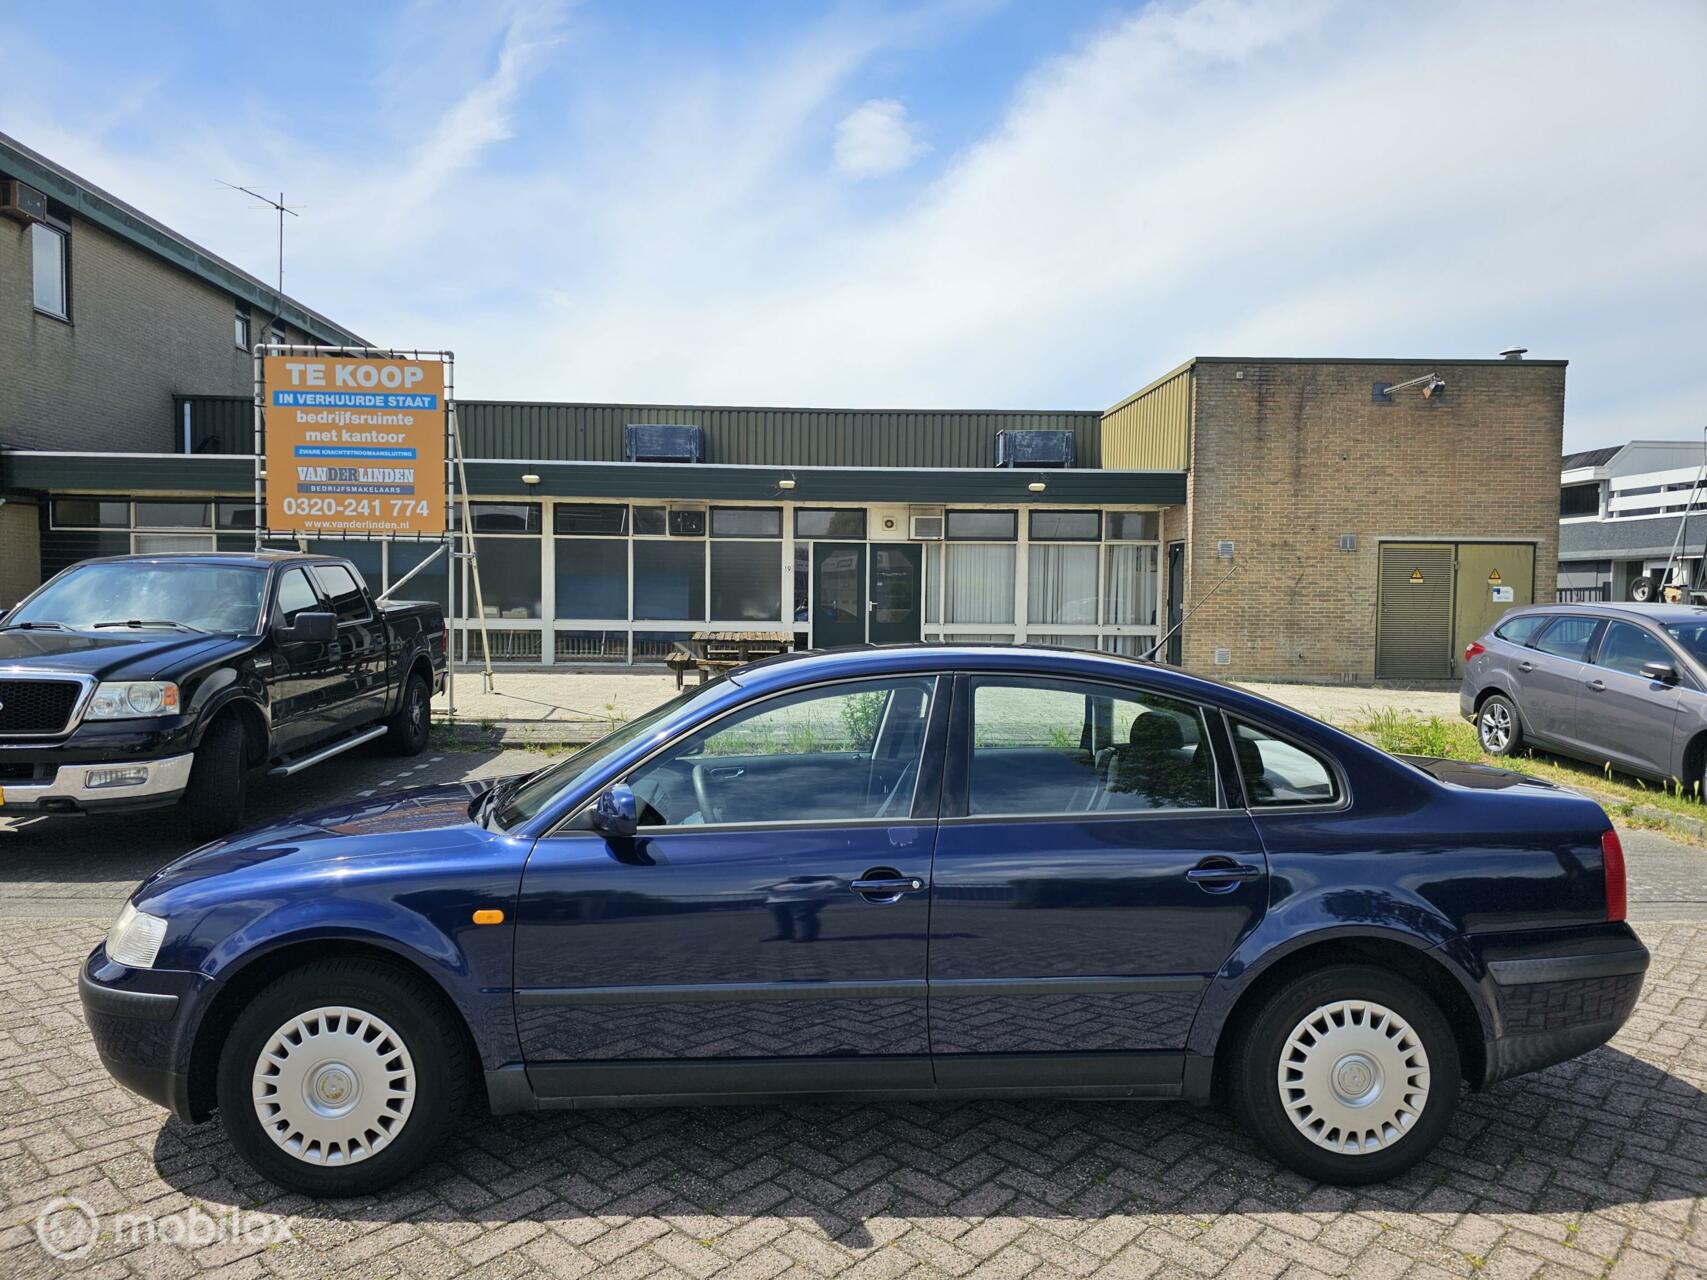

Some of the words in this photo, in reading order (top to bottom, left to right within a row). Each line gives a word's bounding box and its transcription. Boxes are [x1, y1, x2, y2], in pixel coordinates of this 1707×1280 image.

[285, 363, 326, 386] TE
[335, 364, 424, 388] KOOP
[279, 393, 295, 404] IN
[297, 394, 385, 406] VERHUURDE
[388, 396, 431, 408] STAAT
[296, 410, 414, 426] bedrijfsruimte
[305, 429, 338, 442] met
[341, 430, 406, 443] kantoor
[311, 485, 401, 493] BEDRIJFSMAKELAARS
[283, 497, 382, 516] 0320-241
[390, 499, 430, 517] 774
[304, 519, 410, 530] www.vanderlinden.nl
